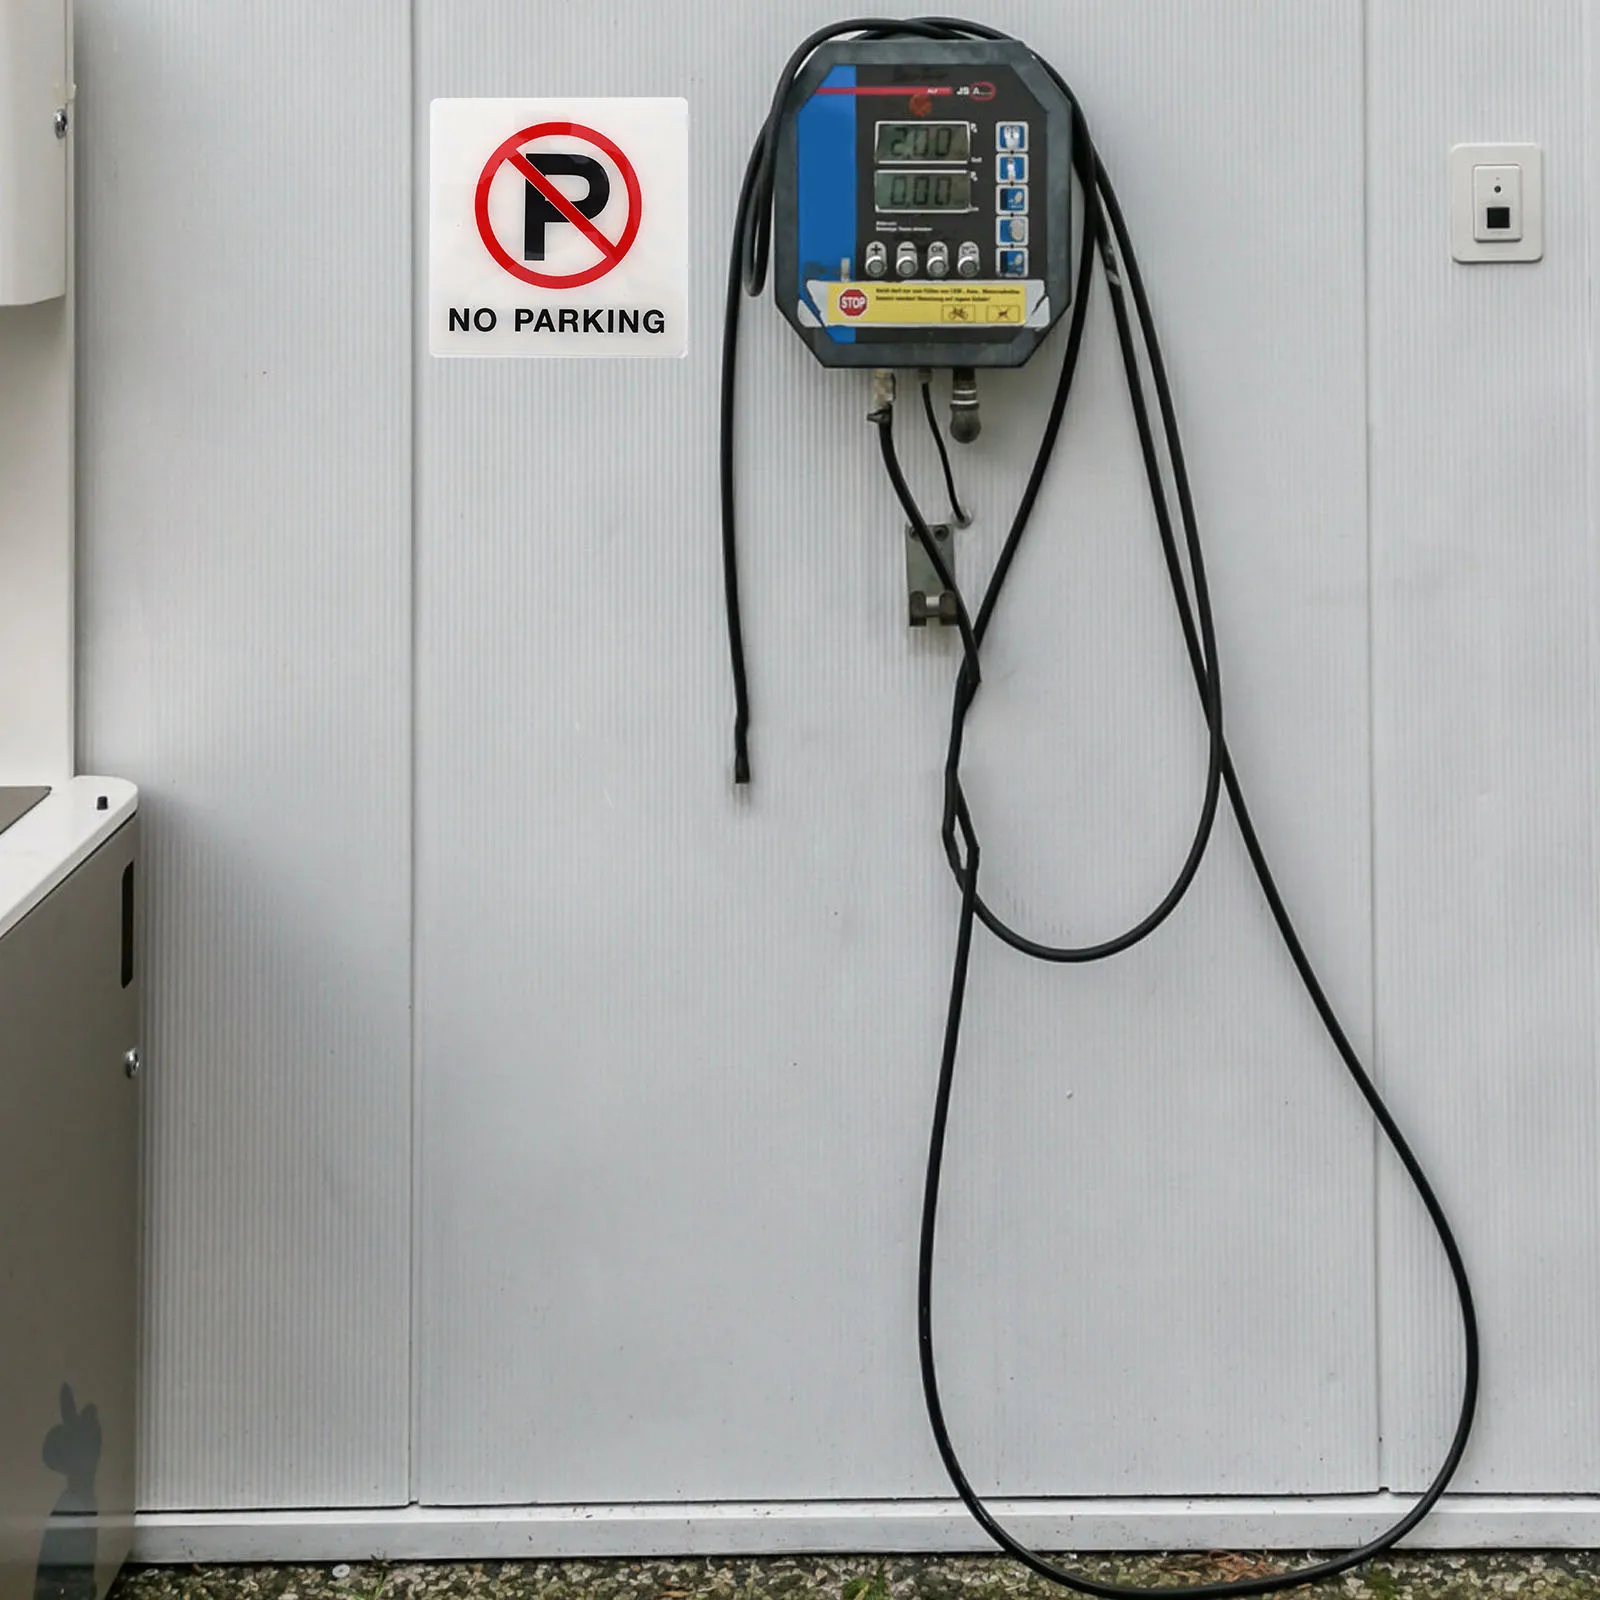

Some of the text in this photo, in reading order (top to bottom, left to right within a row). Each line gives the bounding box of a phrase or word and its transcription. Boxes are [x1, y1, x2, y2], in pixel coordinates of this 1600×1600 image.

[524, 153, 610, 261] P
[841, 296, 866, 309] STOP
[449, 307, 665, 334] NO PARKING
